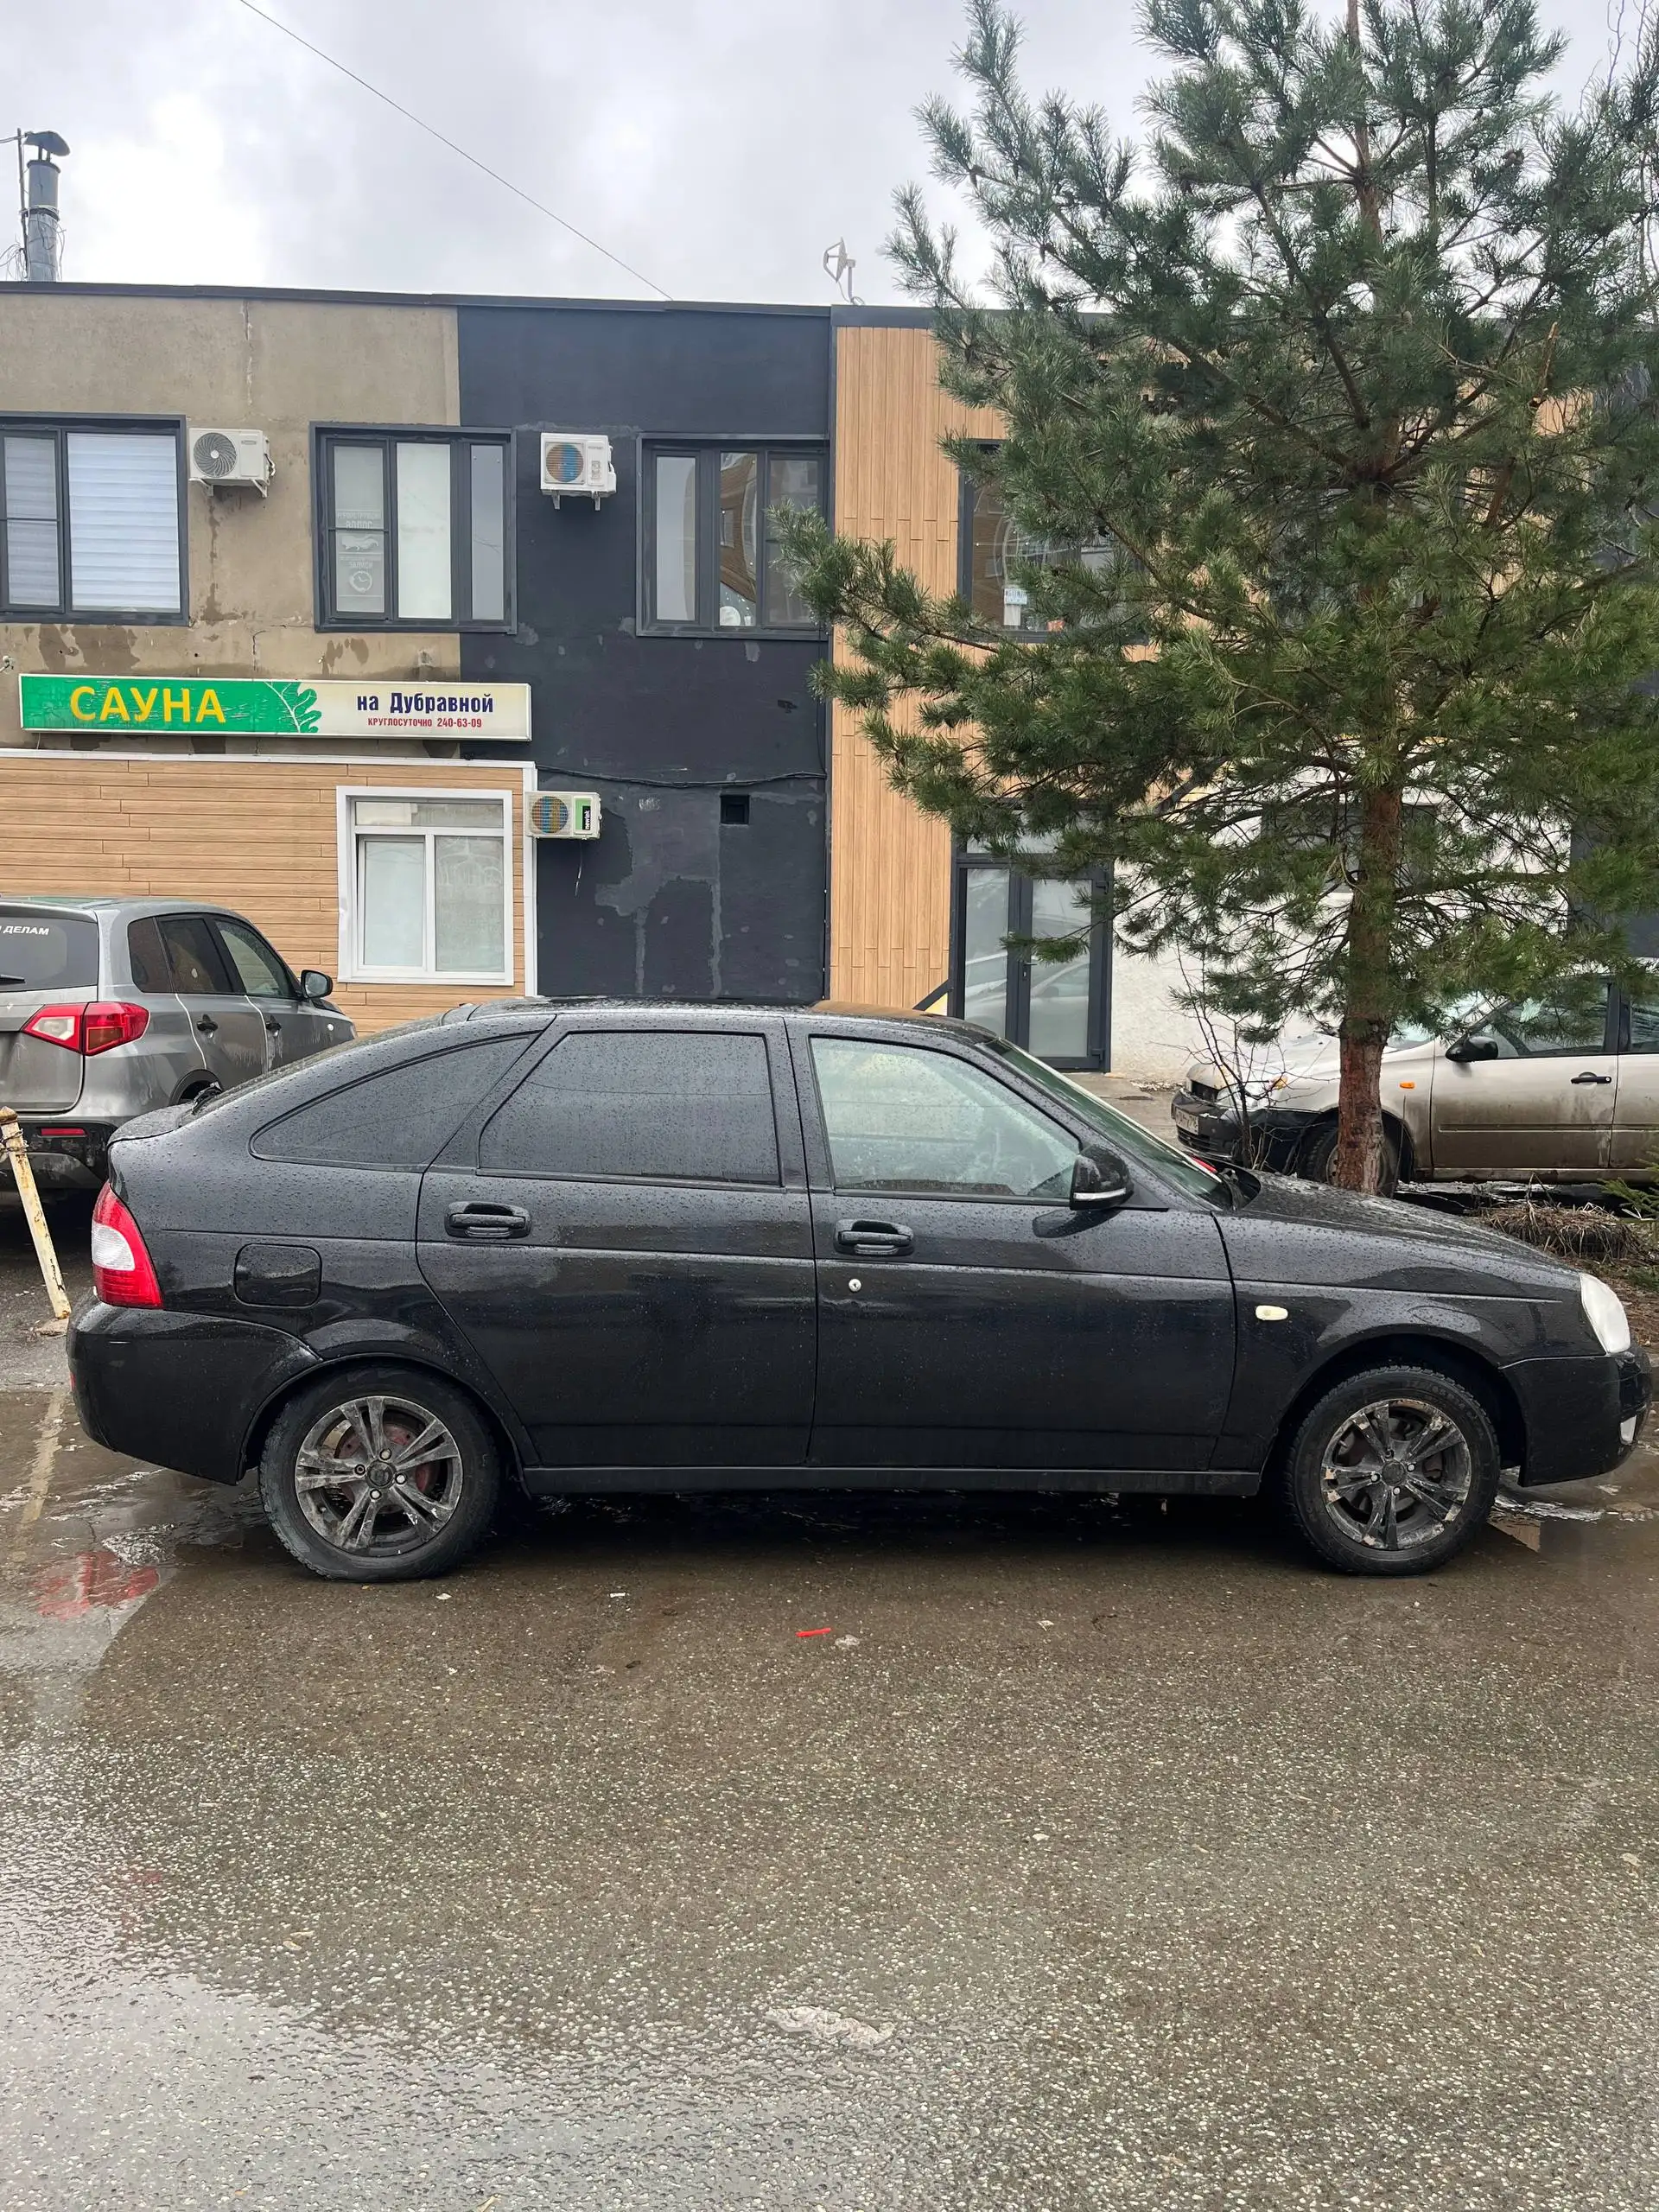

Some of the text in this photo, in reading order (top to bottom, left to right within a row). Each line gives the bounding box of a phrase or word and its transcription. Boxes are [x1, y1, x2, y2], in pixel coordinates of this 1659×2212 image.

[70, 686, 226, 722] САУНА
[357, 692, 493, 714] на Дубравной
[368, 718, 482, 728] КРУГЛОСУТОЧНО 240-63-09
[3, 925, 50, 935] ДЕЛАМ
